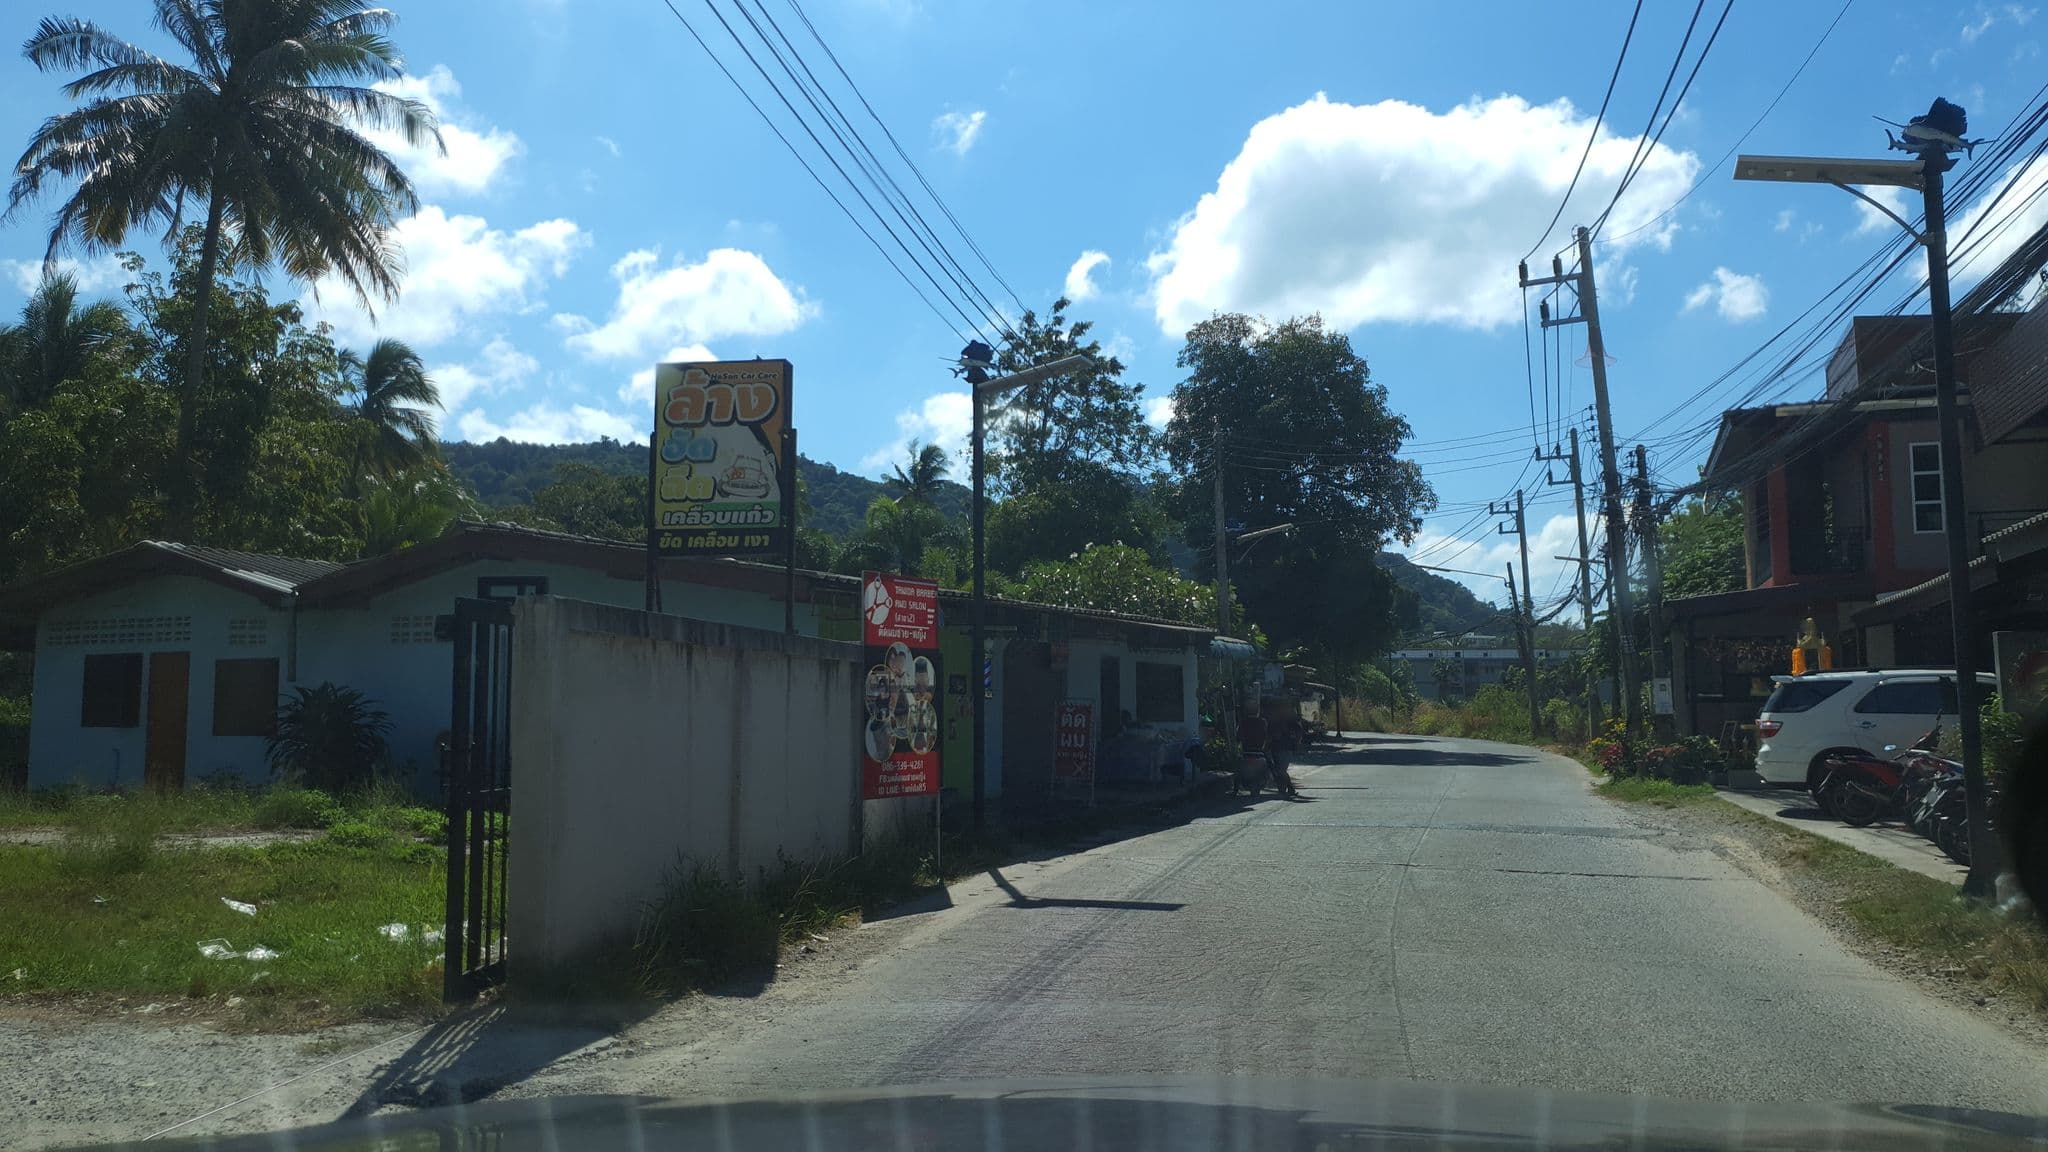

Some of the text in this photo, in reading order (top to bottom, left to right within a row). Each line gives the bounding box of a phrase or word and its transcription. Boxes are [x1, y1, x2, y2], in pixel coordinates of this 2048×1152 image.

[741, 372, 755, 380] Car
[758, 372, 778, 380] Care
[665, 368, 777, 425] ล้าง
[663, 503, 775, 526] เคลือบแก้ว
[1062, 706, 1086, 728] ตัด
